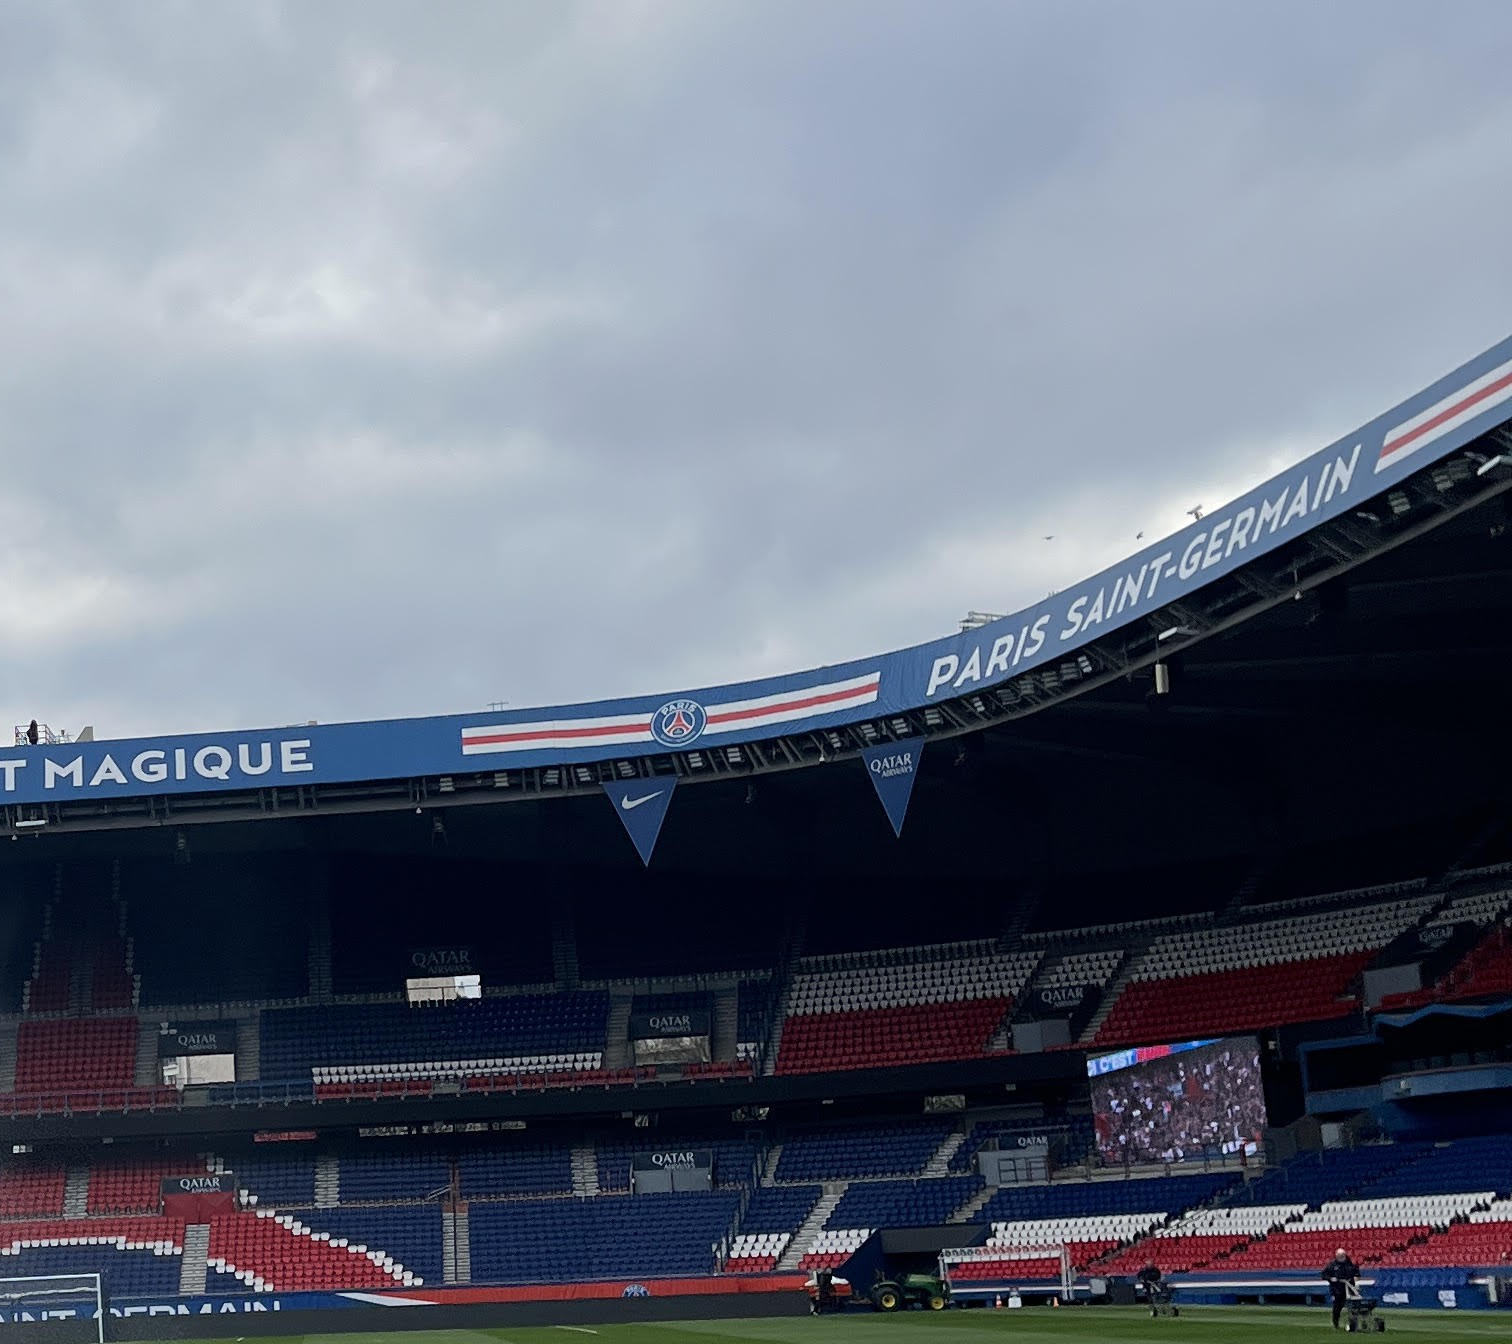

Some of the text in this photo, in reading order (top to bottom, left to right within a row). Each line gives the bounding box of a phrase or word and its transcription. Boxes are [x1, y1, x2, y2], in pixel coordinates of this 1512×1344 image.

[926, 444, 1362, 696] PARIS SAINT-GERMAIN
[660, 701, 697, 716] PARIS
[44, 740, 314, 789] MAGIQUE
[870, 752, 912, 773] QATAR
[411, 950, 471, 969] QATAR
[1041, 987, 1084, 1005] QATAR
[649, 1016, 690, 1029] QATAR
[178, 1034, 216, 1046] QATAR
[1017, 1136, 1048, 1147] QATAR
[651, 1151, 695, 1166] QATAR
[179, 1177, 220, 1191] QATAR
